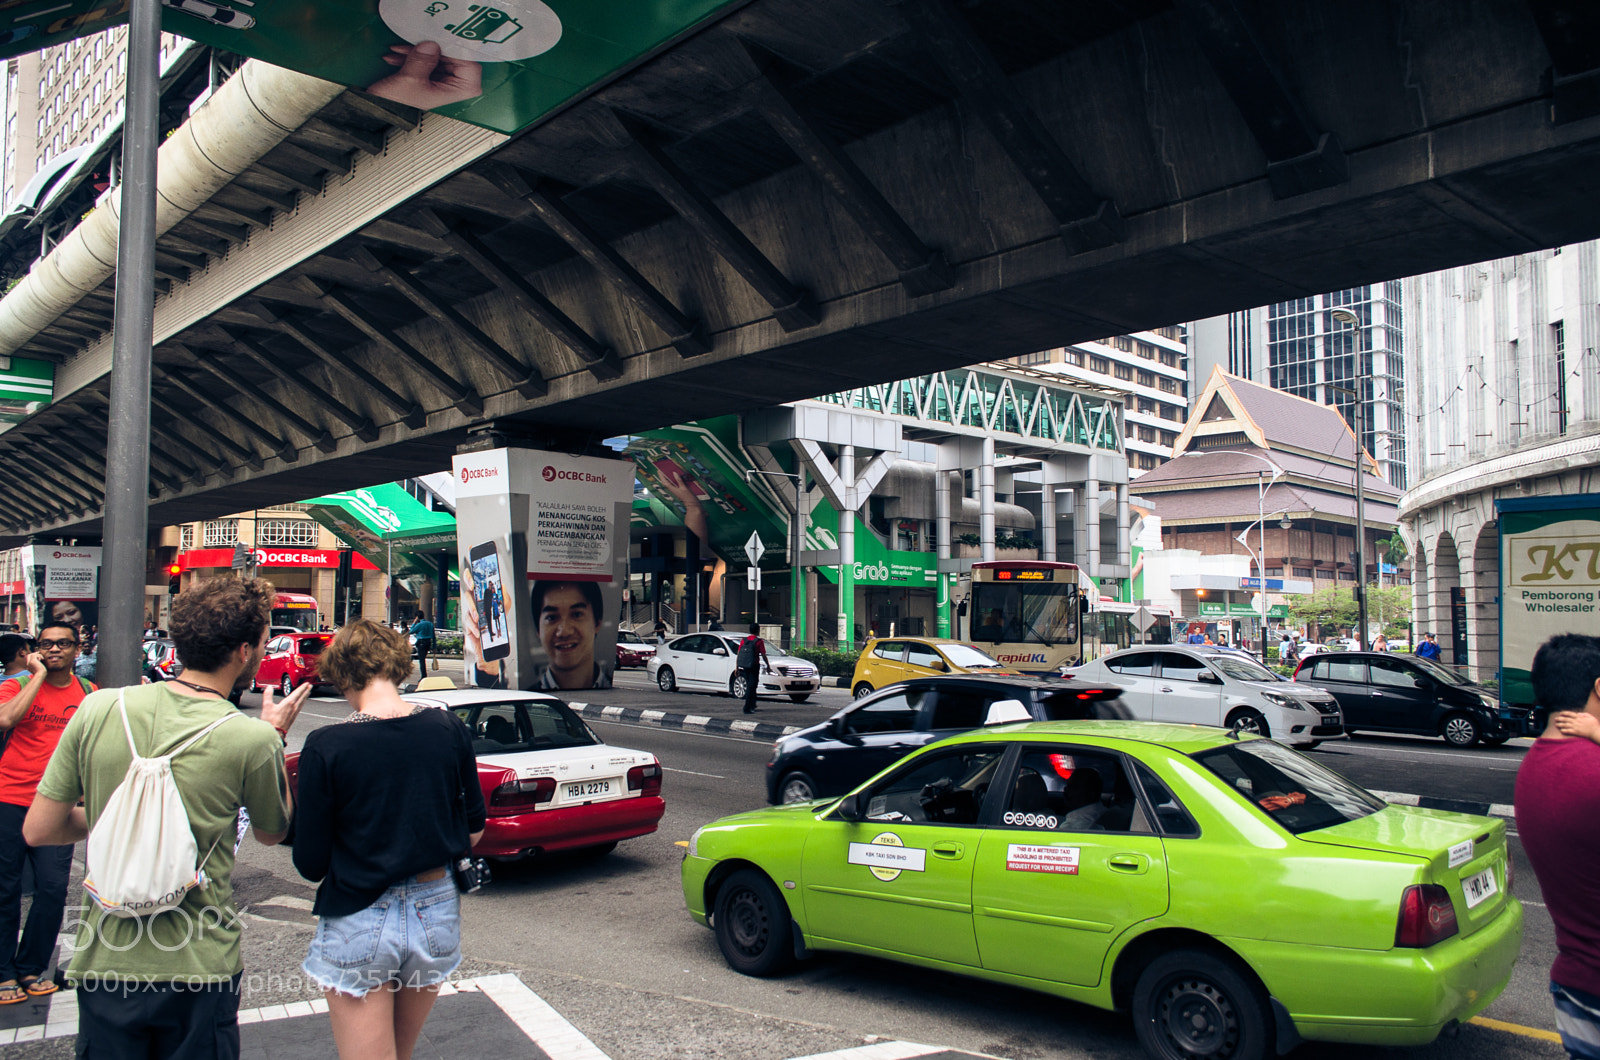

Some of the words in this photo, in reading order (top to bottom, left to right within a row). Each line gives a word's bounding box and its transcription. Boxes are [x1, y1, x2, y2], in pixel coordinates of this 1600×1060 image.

[424, 1, 449, 17] Car
[469, 469, 485, 479] OCBC
[485, 467, 498, 477] Bank
[558, 470, 584, 481] OCBC
[586, 473, 607, 484] Bank
[587, 505, 607, 513] BOLEH
[538, 511, 591, 522] MENANGGUNG
[592, 514, 606, 523] KOS
[537, 520, 590, 531] PERKAHWINAN
[591, 523, 606, 532] DAN
[537, 529, 606, 541] MENGEMBANGKAN
[268, 553, 300, 563] OCBC
[301, 553, 328, 564] Bank
[853, 560, 889, 581] Grab
[1521, 590, 1594, 602] Pemborong
[1525, 602, 1595, 613] Wholesaler
[996, 653, 1048, 664] rapidKL
[33, 704, 45, 714] The
[568, 784, 585, 798] HBA
[588, 781, 610, 795] 2279
[1055, 865, 1076, 873] RECEIPT
[123, 885, 187, 910] ISPO.COM
